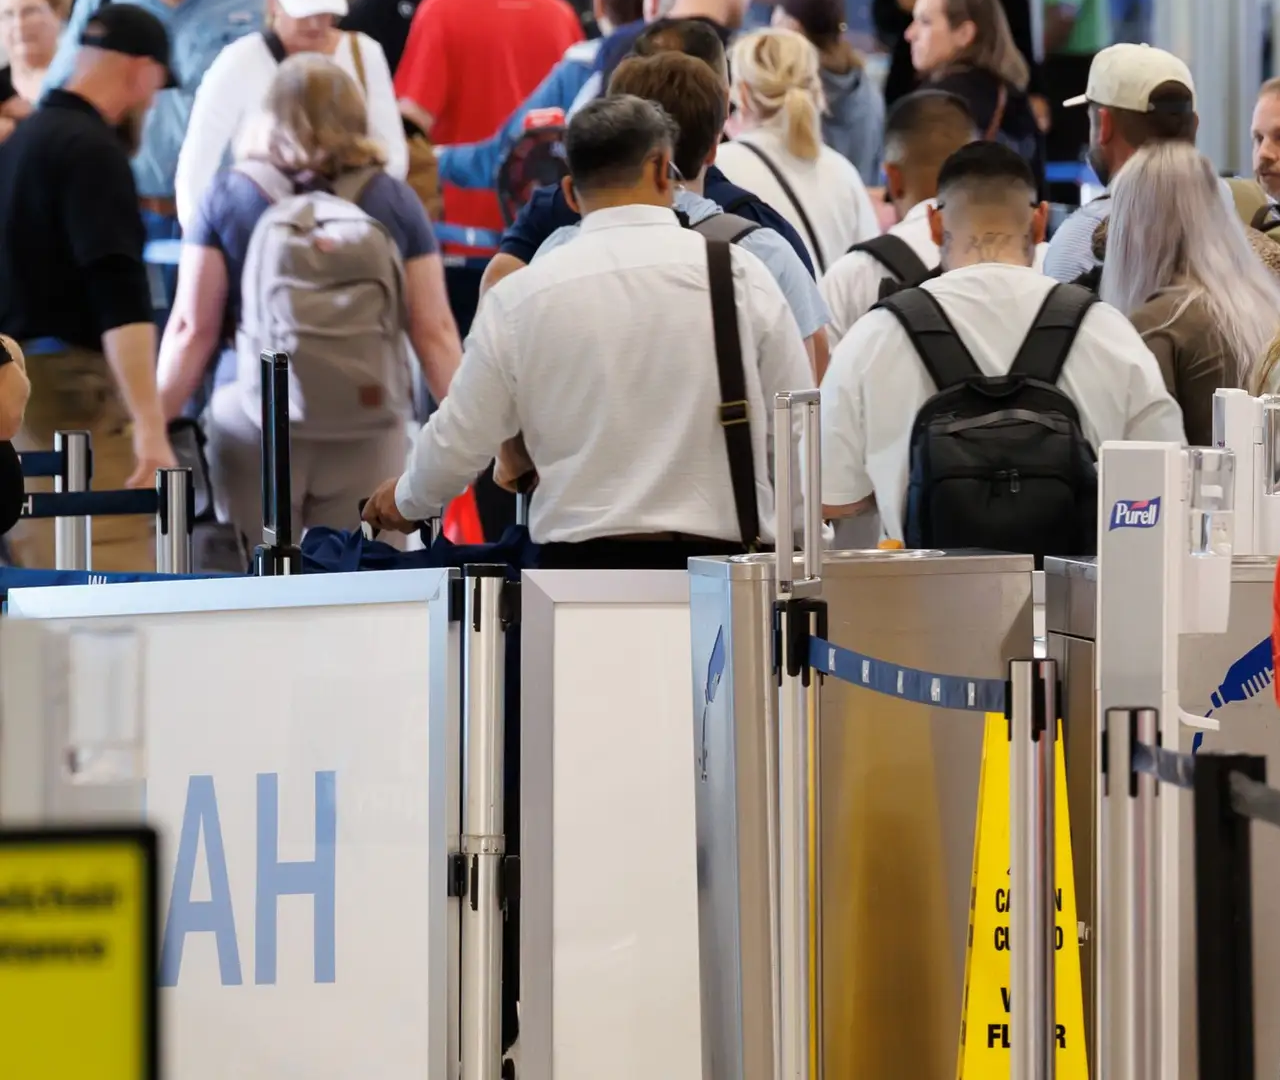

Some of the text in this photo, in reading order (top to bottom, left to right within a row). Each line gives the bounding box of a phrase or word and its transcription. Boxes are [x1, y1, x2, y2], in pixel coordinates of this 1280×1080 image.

[1114, 502, 1158, 525] Purell
[142, 770, 336, 988] AH
[987, 1023, 1067, 1049] FLR
